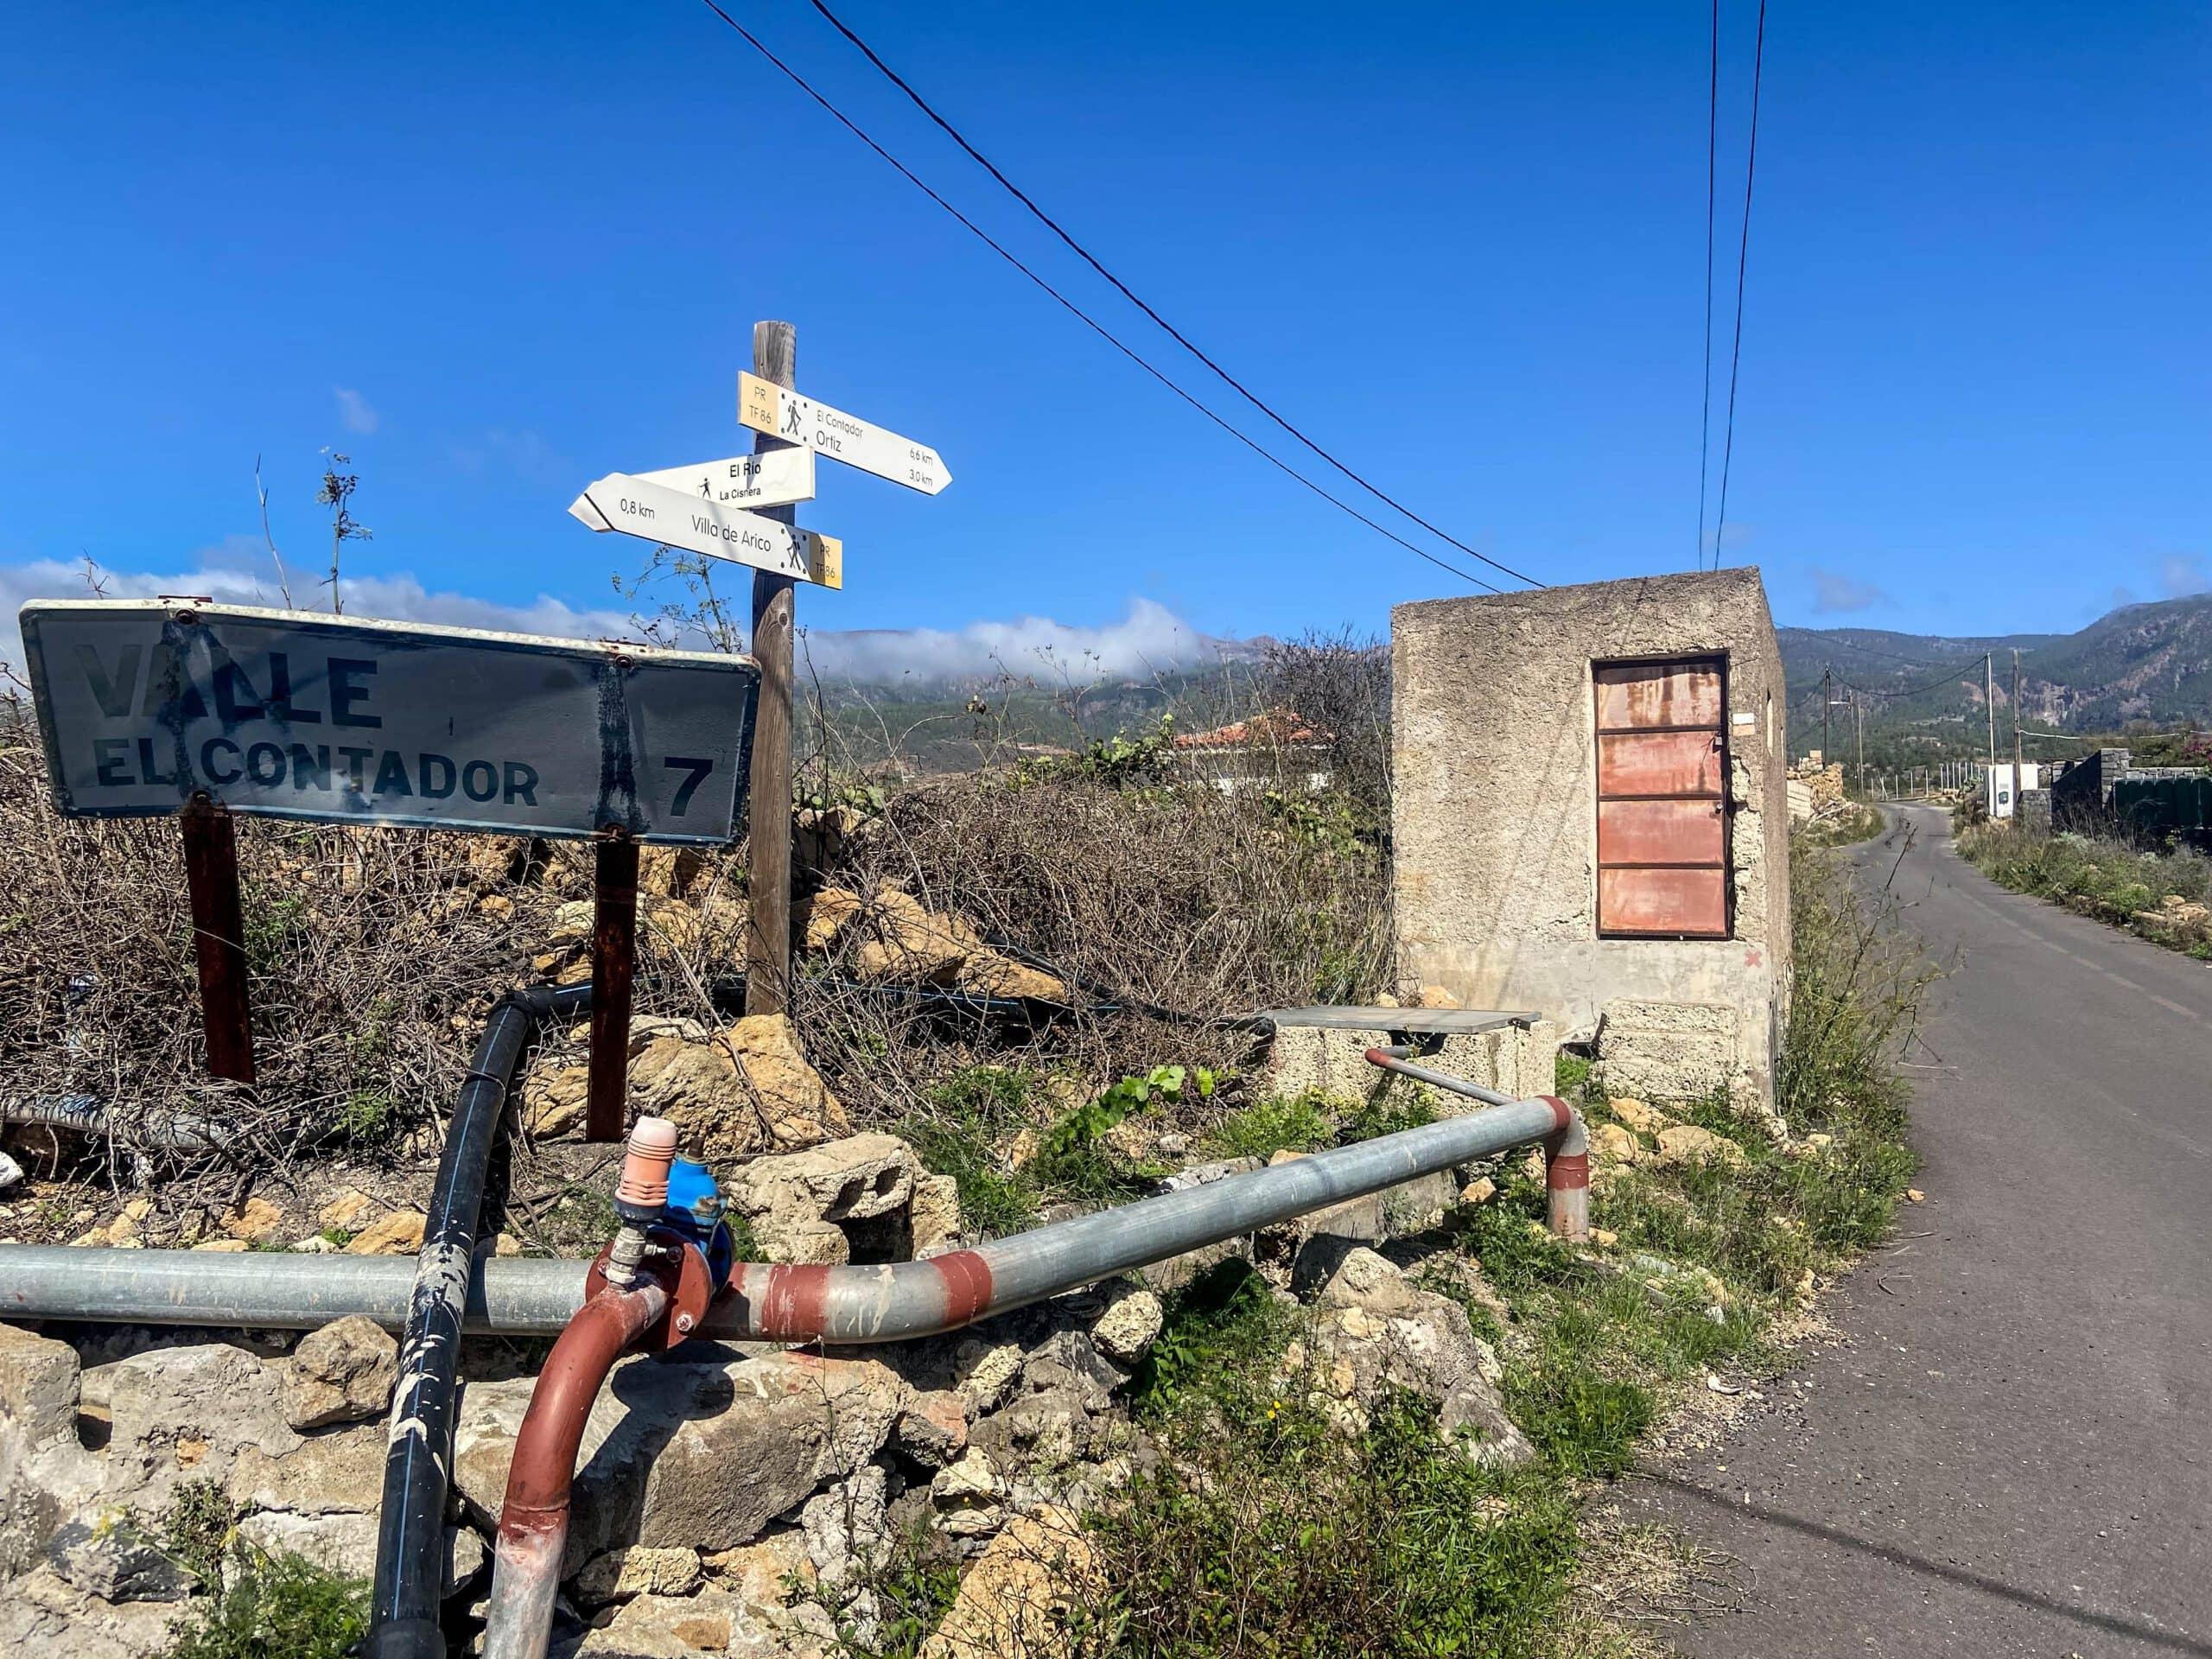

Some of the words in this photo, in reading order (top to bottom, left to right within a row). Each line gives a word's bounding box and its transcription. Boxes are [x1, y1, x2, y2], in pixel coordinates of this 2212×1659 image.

[754, 386, 766, 401] PR
[748, 405, 759, 419] TF
[760, 410, 772, 424] 86
[817, 410, 824, 422] El
[825, 413, 864, 438] Contador
[816, 430, 842, 453] Ortiz
[921, 451, 933, 467] km
[729, 464, 740, 478] El
[743, 461, 761, 476] Río
[921, 472, 933, 486] km
[720, 490, 729, 501] La
[731, 487, 761, 499] Cisnera
[620, 498, 637, 515] 0,8
[639, 503, 655, 519] km
[691, 514, 718, 537] Villa
[722, 524, 739, 543] de
[741, 531, 772, 552] Arico
[820, 544, 830, 558] PR
[816, 563, 825, 575] TF
[825, 565, 836, 579] 86
[74, 644, 383, 728] VALLE
[93, 737, 175, 787] EL
[200, 737, 540, 807] CONTADOR
[664, 756, 714, 817] 7
